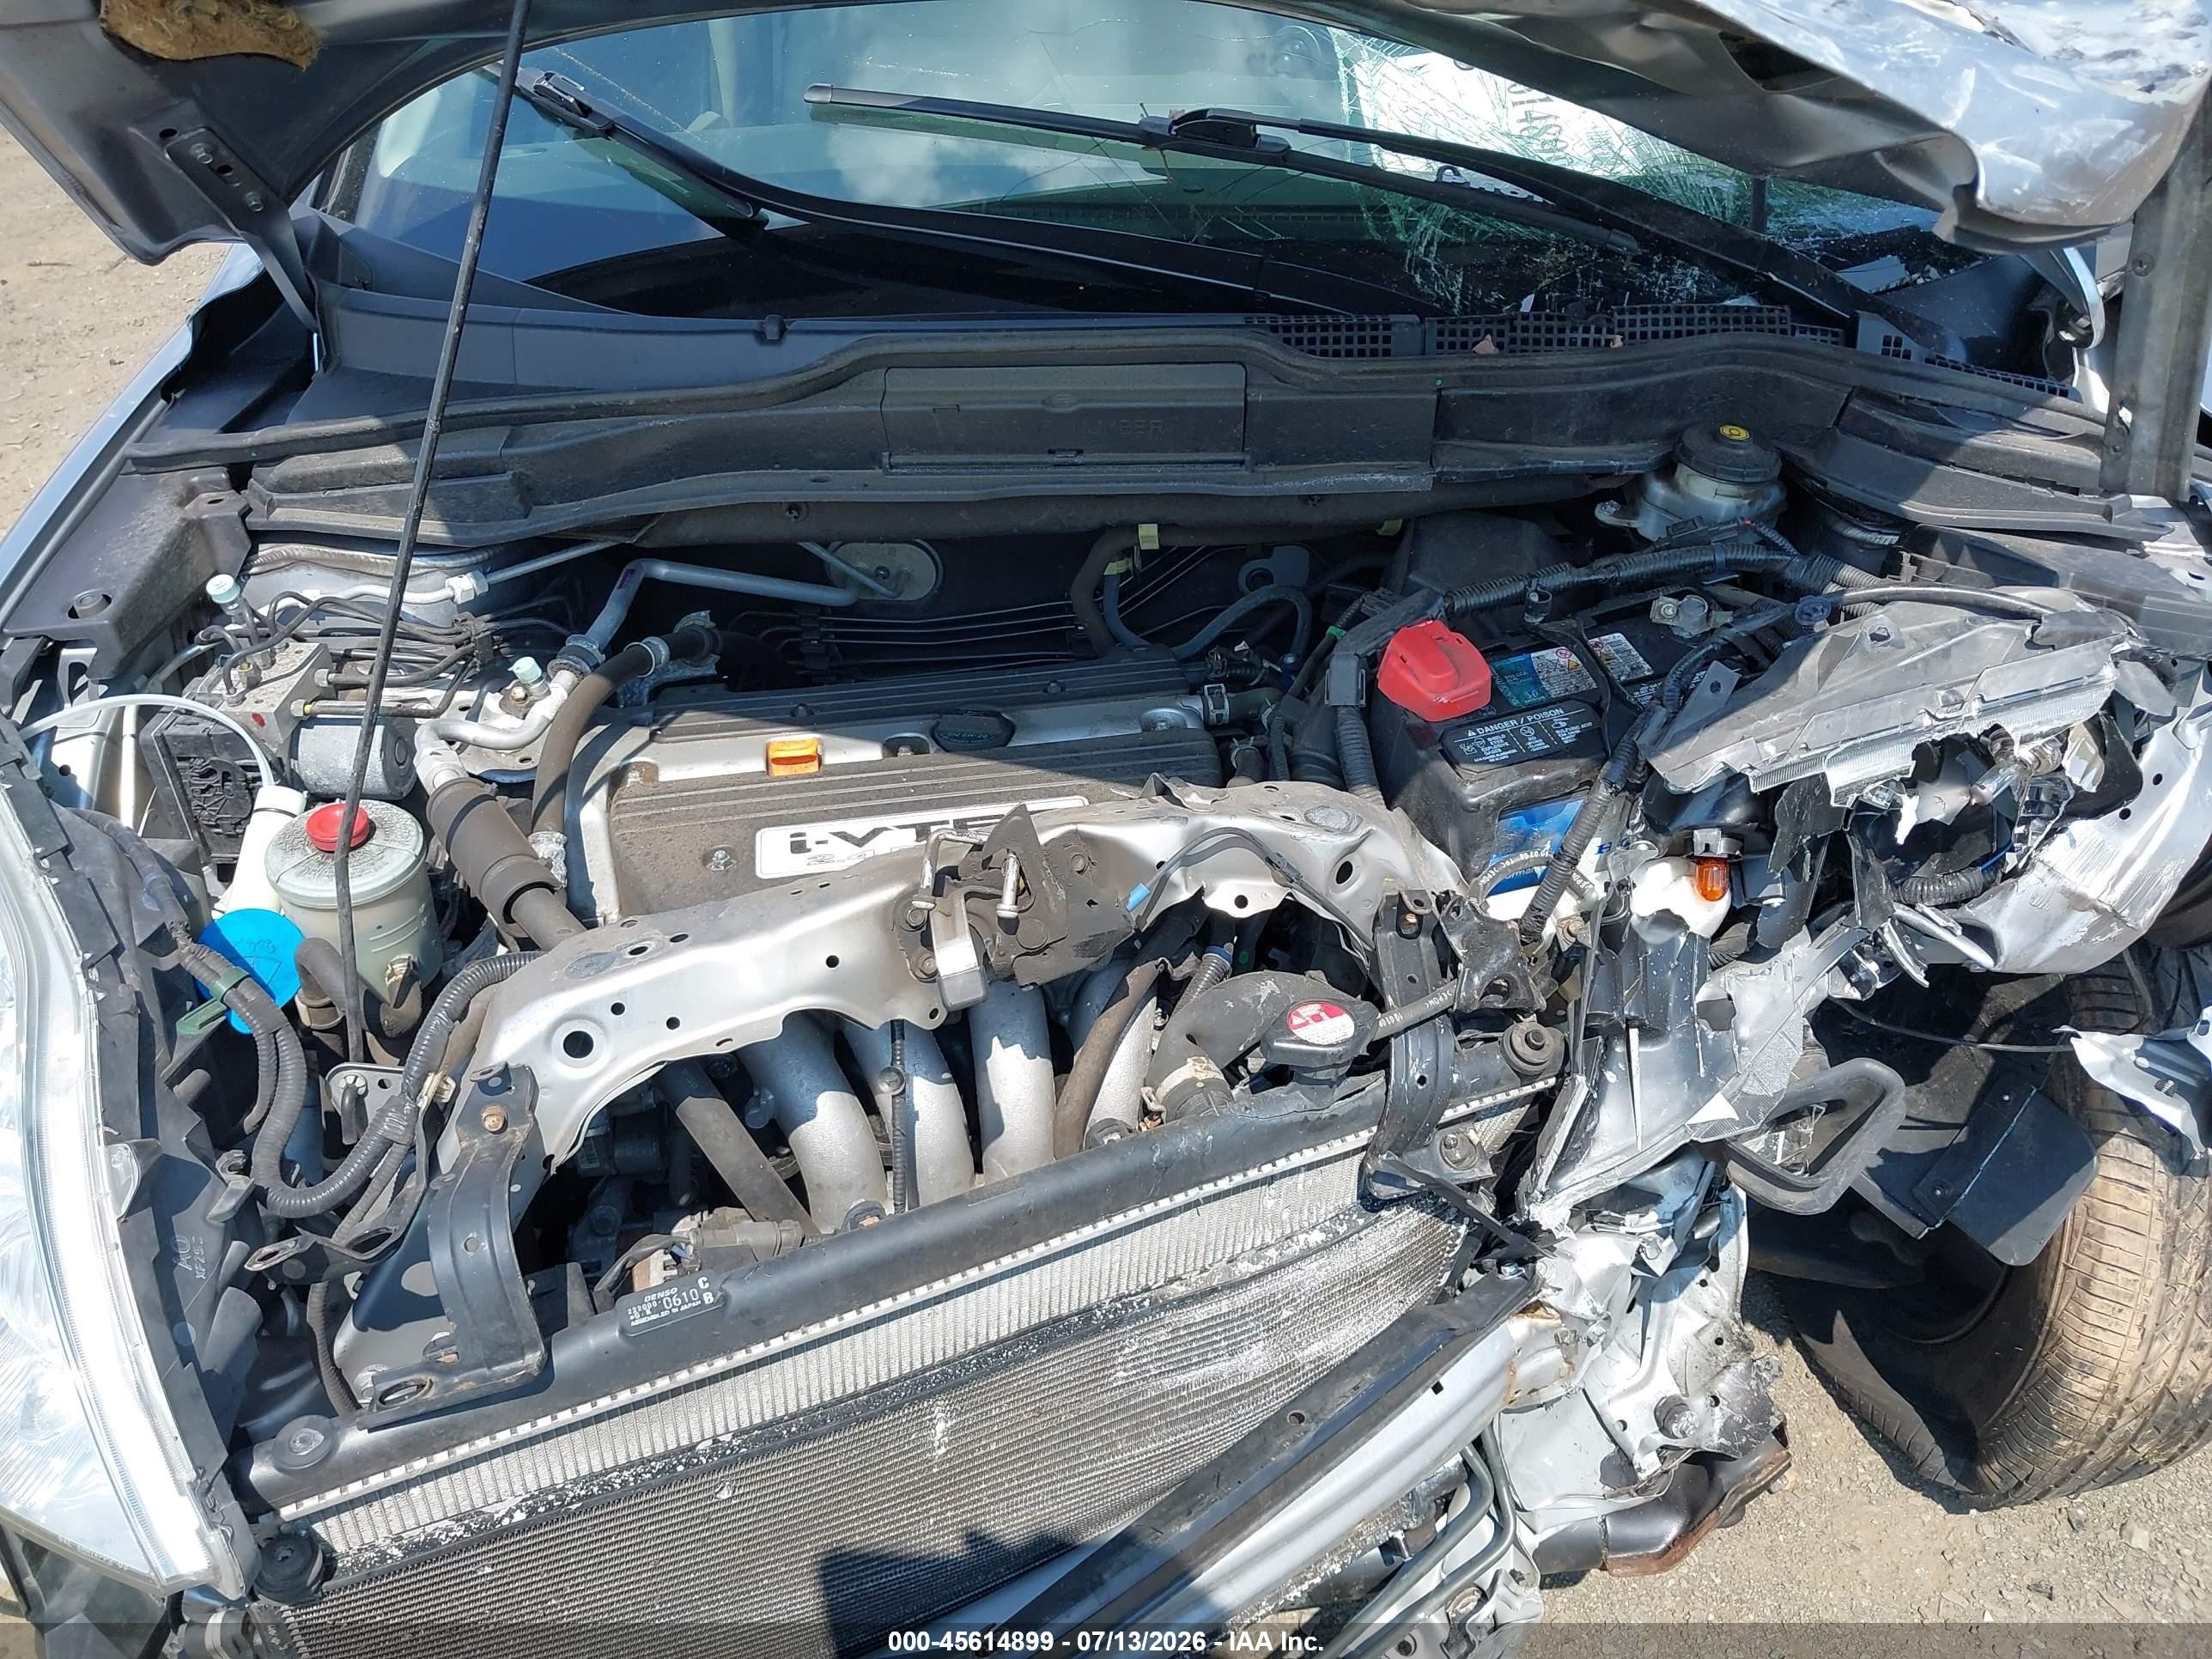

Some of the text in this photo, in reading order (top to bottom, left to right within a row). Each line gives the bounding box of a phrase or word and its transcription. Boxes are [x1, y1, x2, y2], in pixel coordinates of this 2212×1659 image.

[1477, 719, 1517, 735] DANGER
[1527, 708, 1565, 722] POISON
[644, 1287, 678, 1303] DENSO
[680, 1300, 702, 1311] JAPAN
